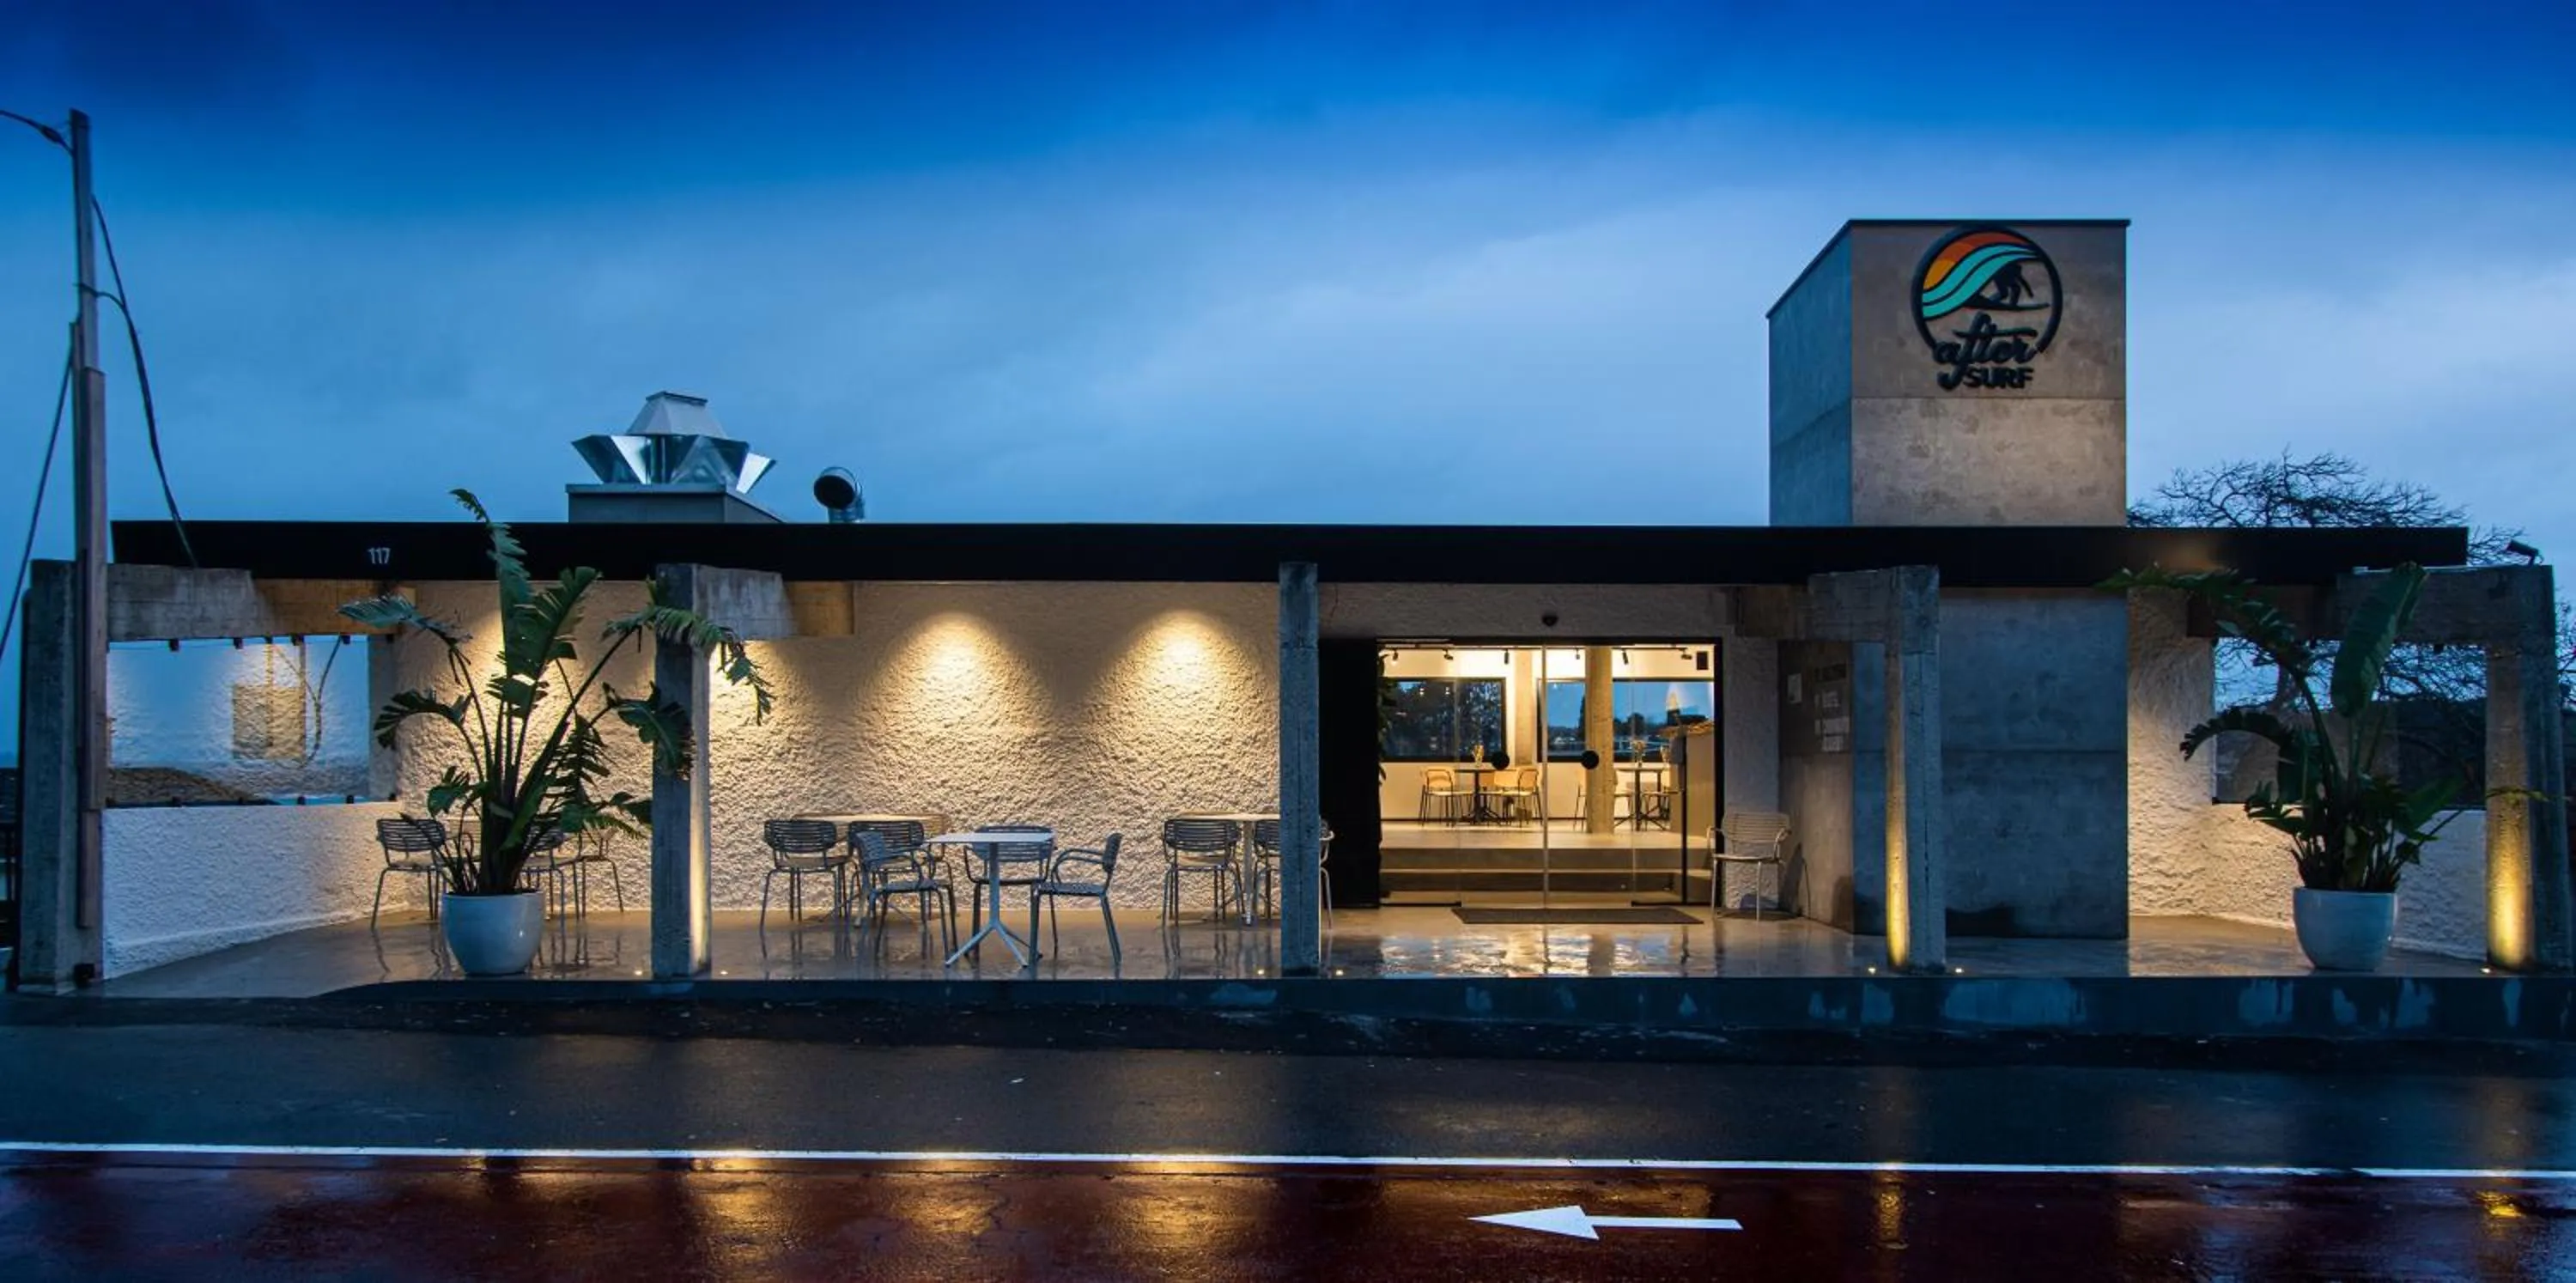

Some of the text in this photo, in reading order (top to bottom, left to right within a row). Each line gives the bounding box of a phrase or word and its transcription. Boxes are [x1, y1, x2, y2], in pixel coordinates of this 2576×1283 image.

[1934, 312, 2038, 390] after
[1965, 367, 2034, 389] SURF
[368, 547, 391, 564] 117
